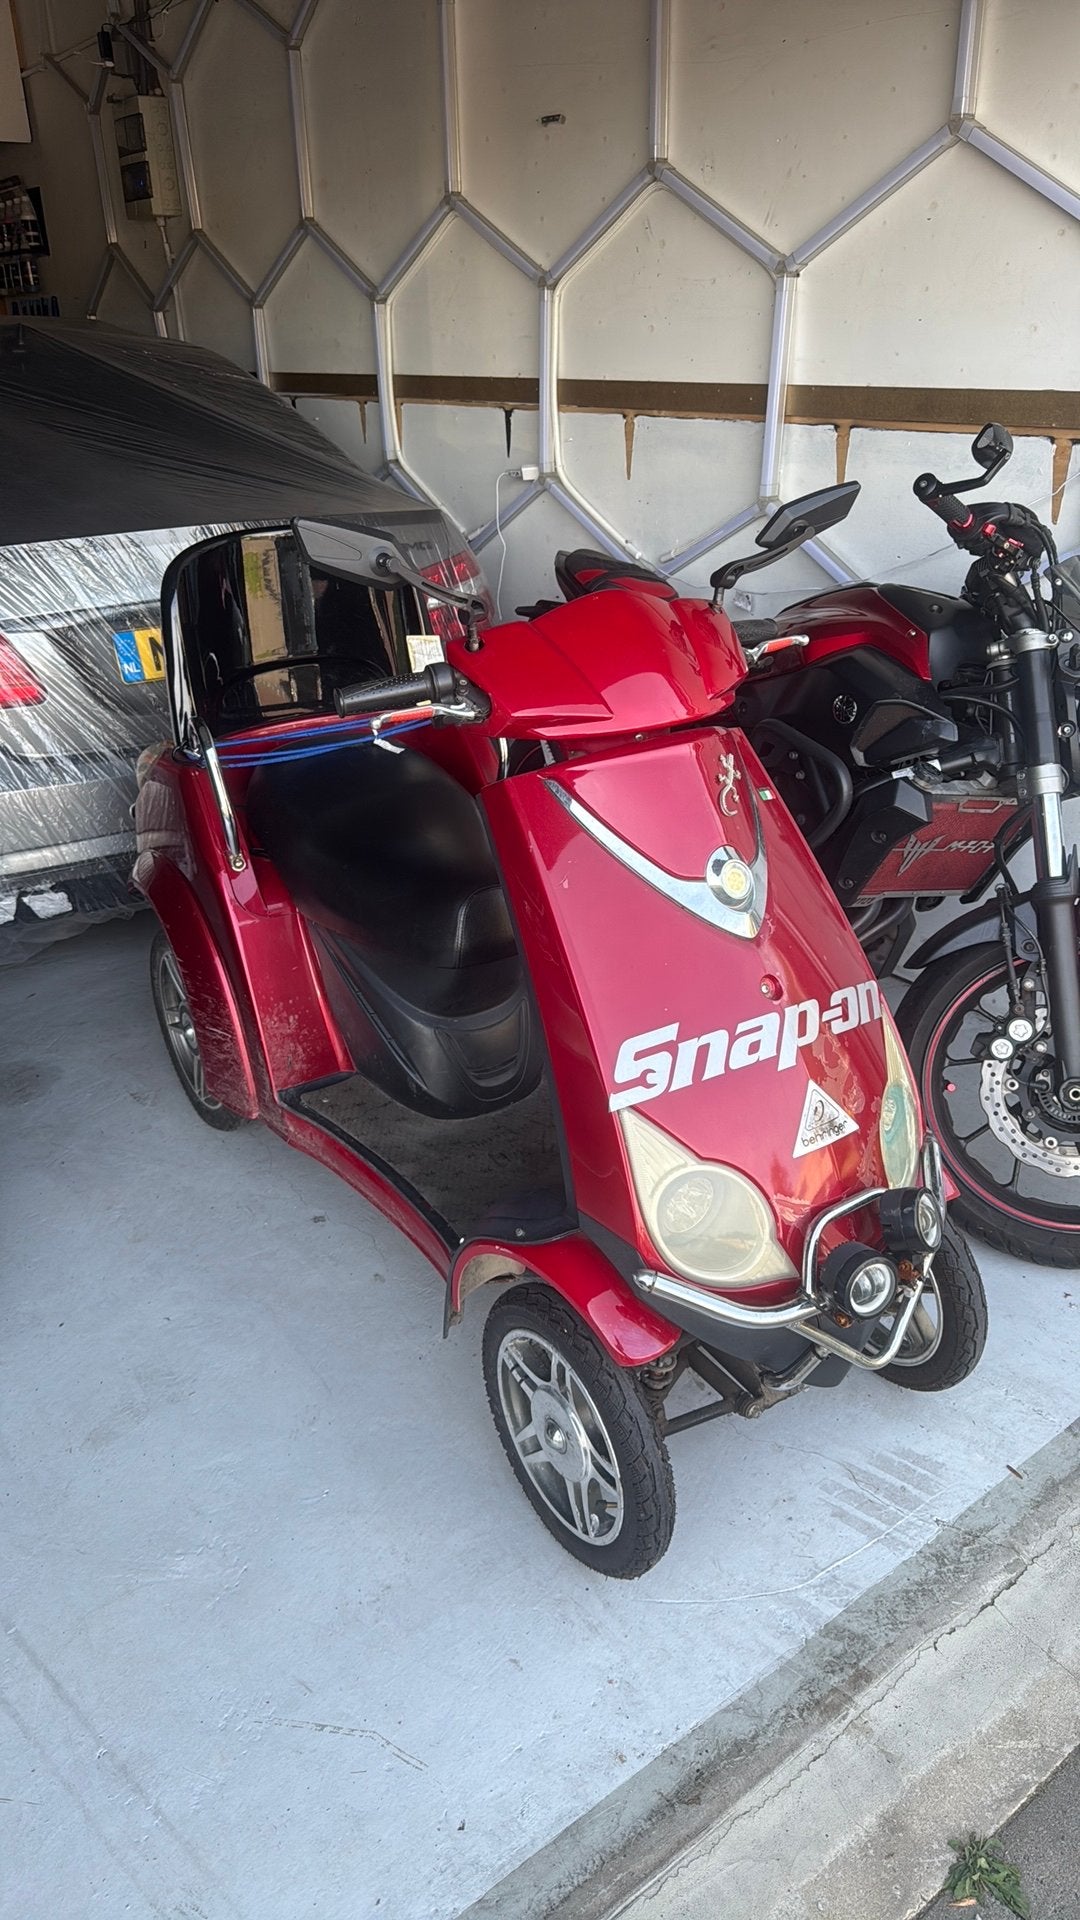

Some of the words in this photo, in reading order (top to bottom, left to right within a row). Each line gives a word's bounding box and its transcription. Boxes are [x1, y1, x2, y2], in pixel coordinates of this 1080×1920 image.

[123, 662, 141, 674] NL
[608, 979, 882, 1113] Snap-on
[800, 1119, 848, 1148] behringer
